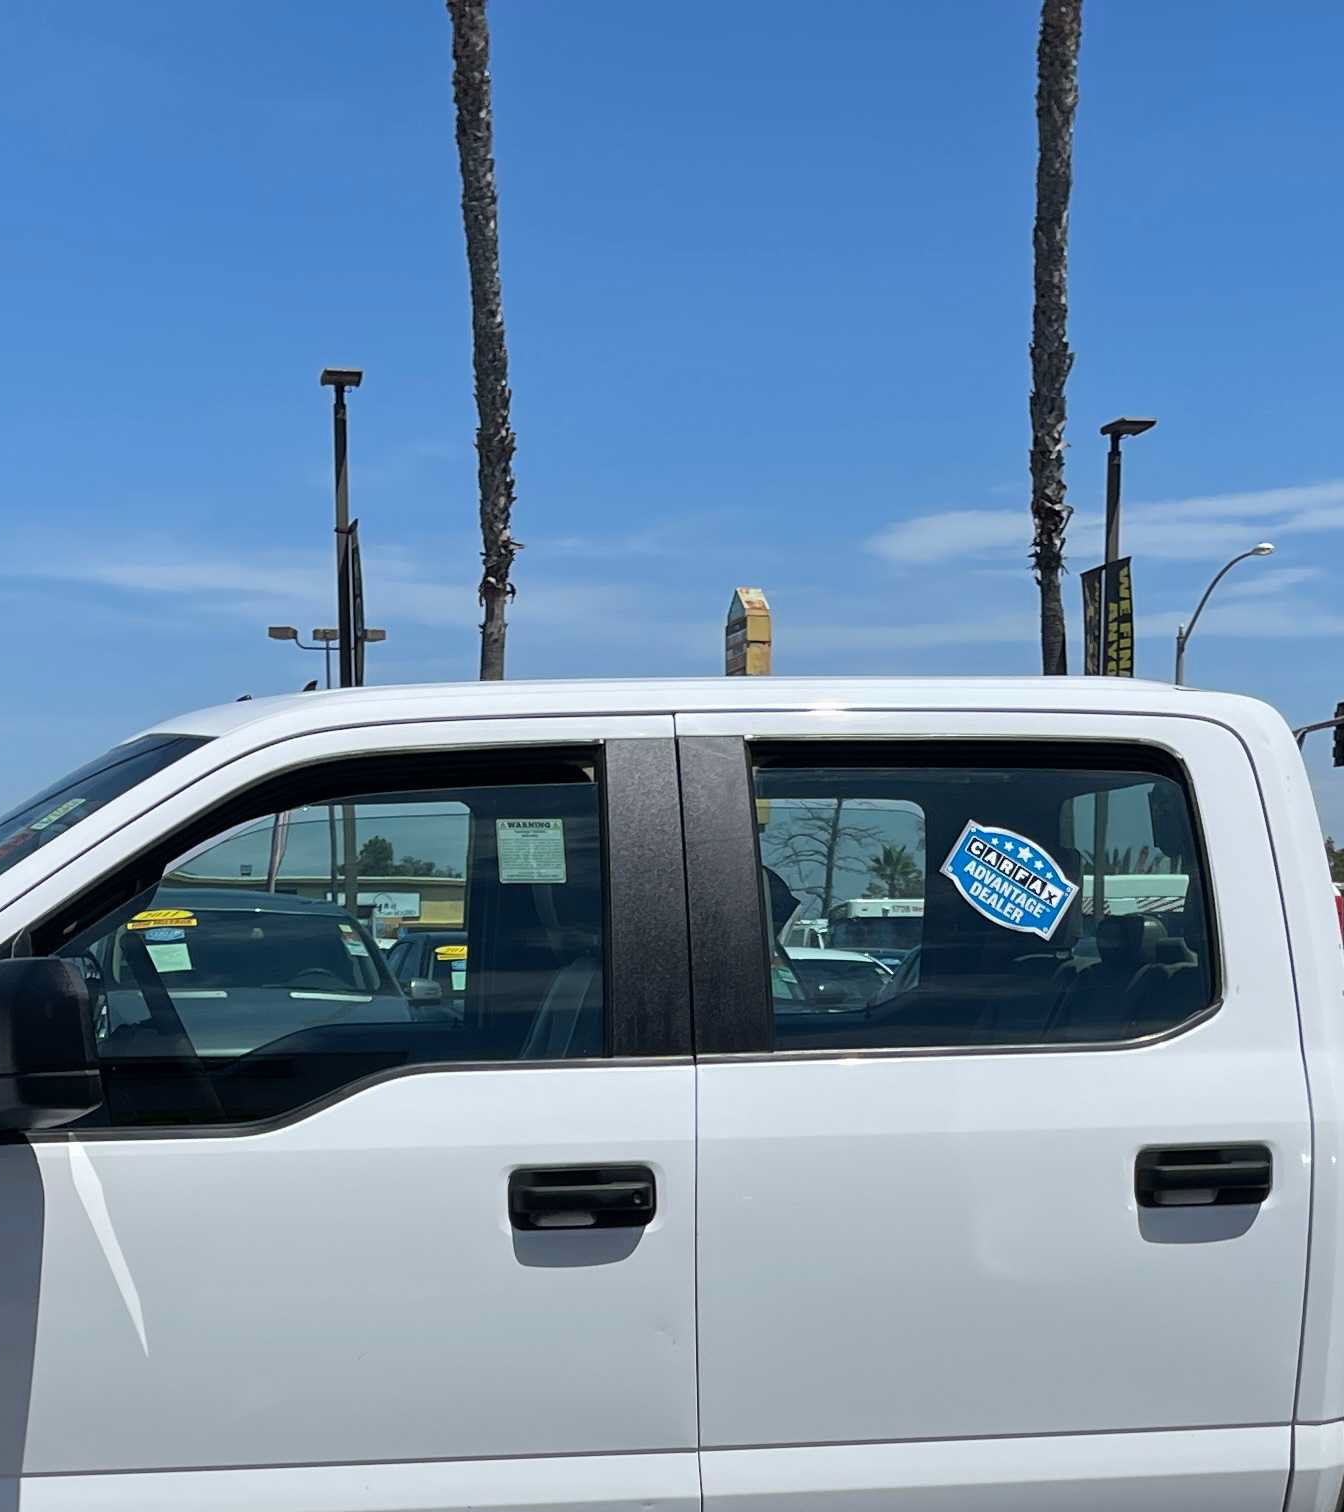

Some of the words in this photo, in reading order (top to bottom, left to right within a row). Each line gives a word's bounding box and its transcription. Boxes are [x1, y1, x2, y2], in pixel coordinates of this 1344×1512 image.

[1119, 566, 1130, 615] WE
[964, 861, 1045, 918] ADVANTAGE
[968, 838, 1061, 907] CARFAX
[969, 882, 1025, 923] DEALER
